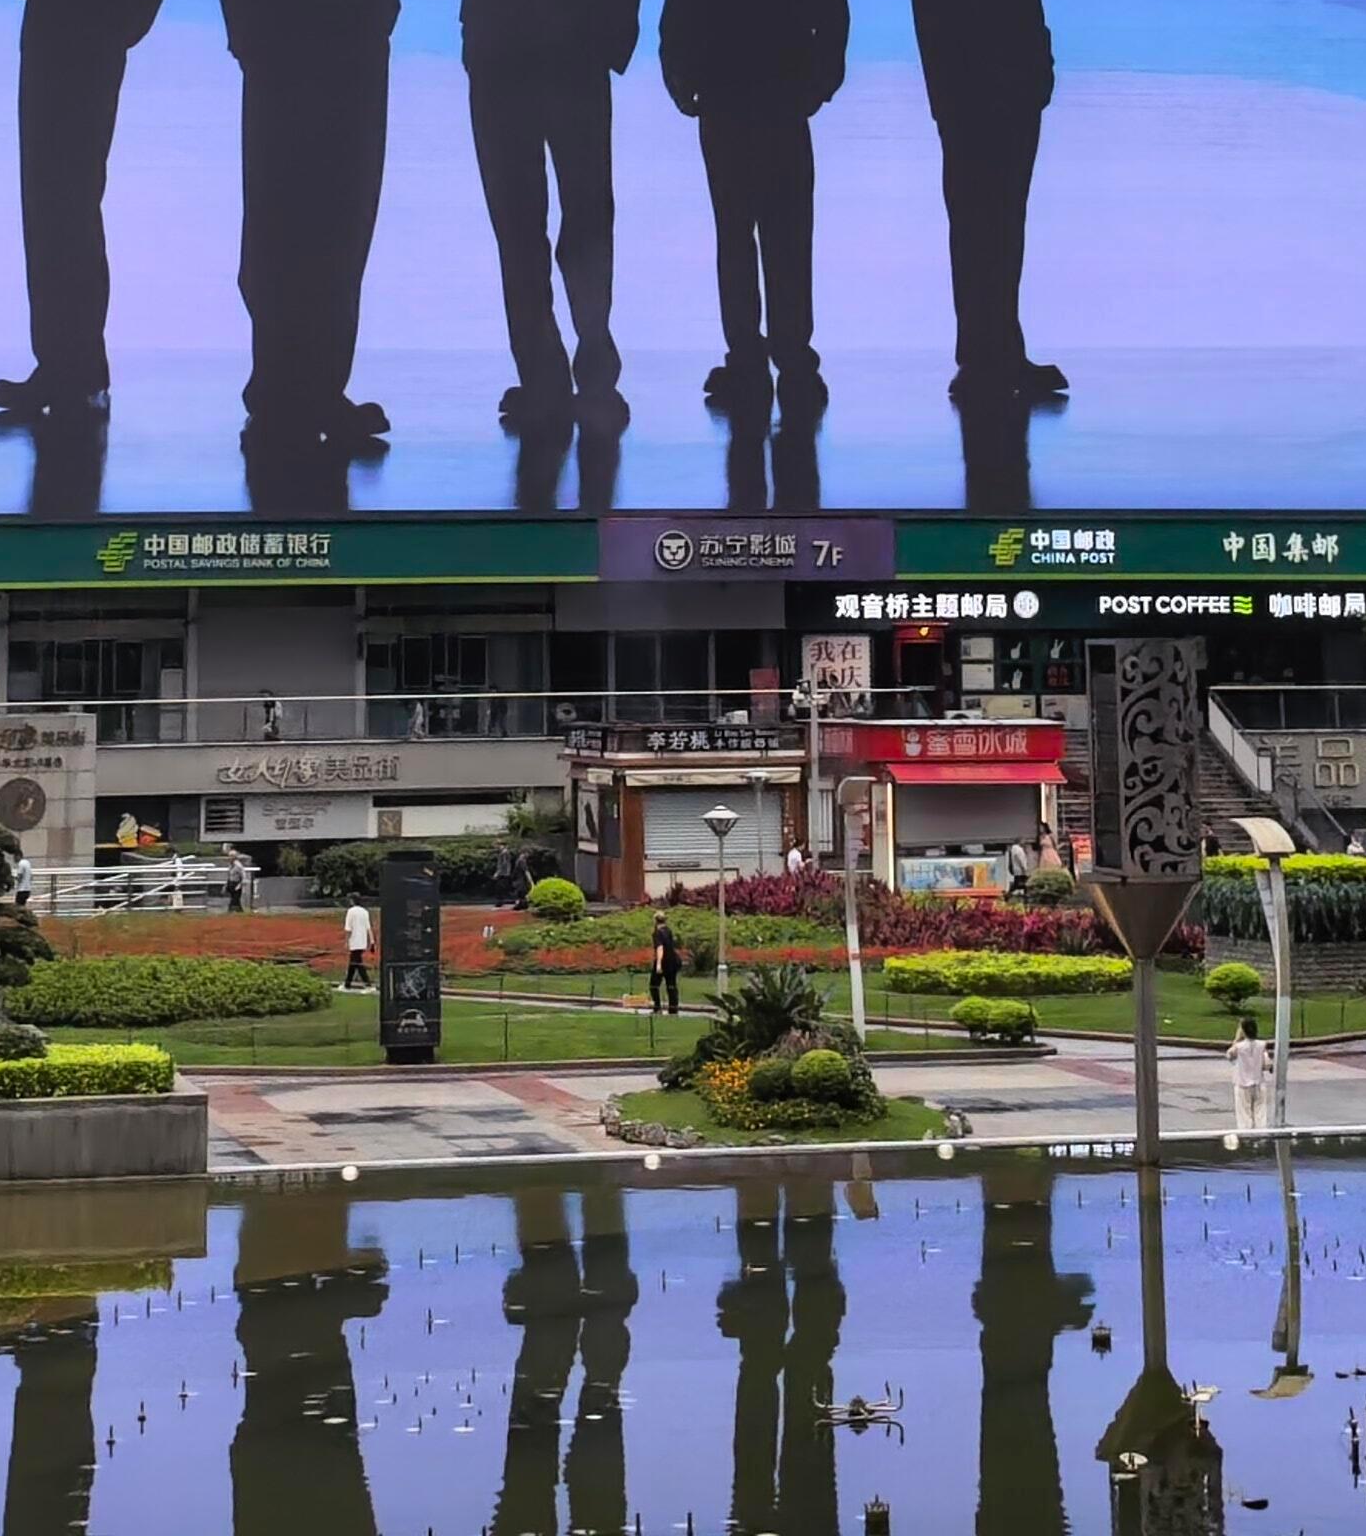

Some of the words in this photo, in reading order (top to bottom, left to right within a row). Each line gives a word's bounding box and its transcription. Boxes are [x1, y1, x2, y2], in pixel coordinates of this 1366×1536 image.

[144, 533, 332, 556] 中国邮政储蓄银行
[699, 534, 796, 555] 苏宁影城
[1030, 529, 1116, 552] 中国邮政
[1222, 531, 1339, 563] 中国集邮
[143, 558, 187, 569] POSTAL
[191, 558, 240, 569] SAVINGS
[243, 558, 273, 568] BANK
[277, 558, 292, 568] OF
[296, 557, 332, 568] CHINA
[812, 540, 844, 567] 7F
[1031, 551, 1075, 564] CHINA
[1080, 551, 1116, 564] POST
[835, 594, 1008, 619] 观音桥主题邮局
[1098, 595, 1152, 615] POST
[1155, 595, 1231, 615] COFFEE
[1269, 592, 1366, 619] 咖啡邮局
[810, 640, 863, 663] 我在
[926, 727, 1029, 756] 蜜雪冰城
